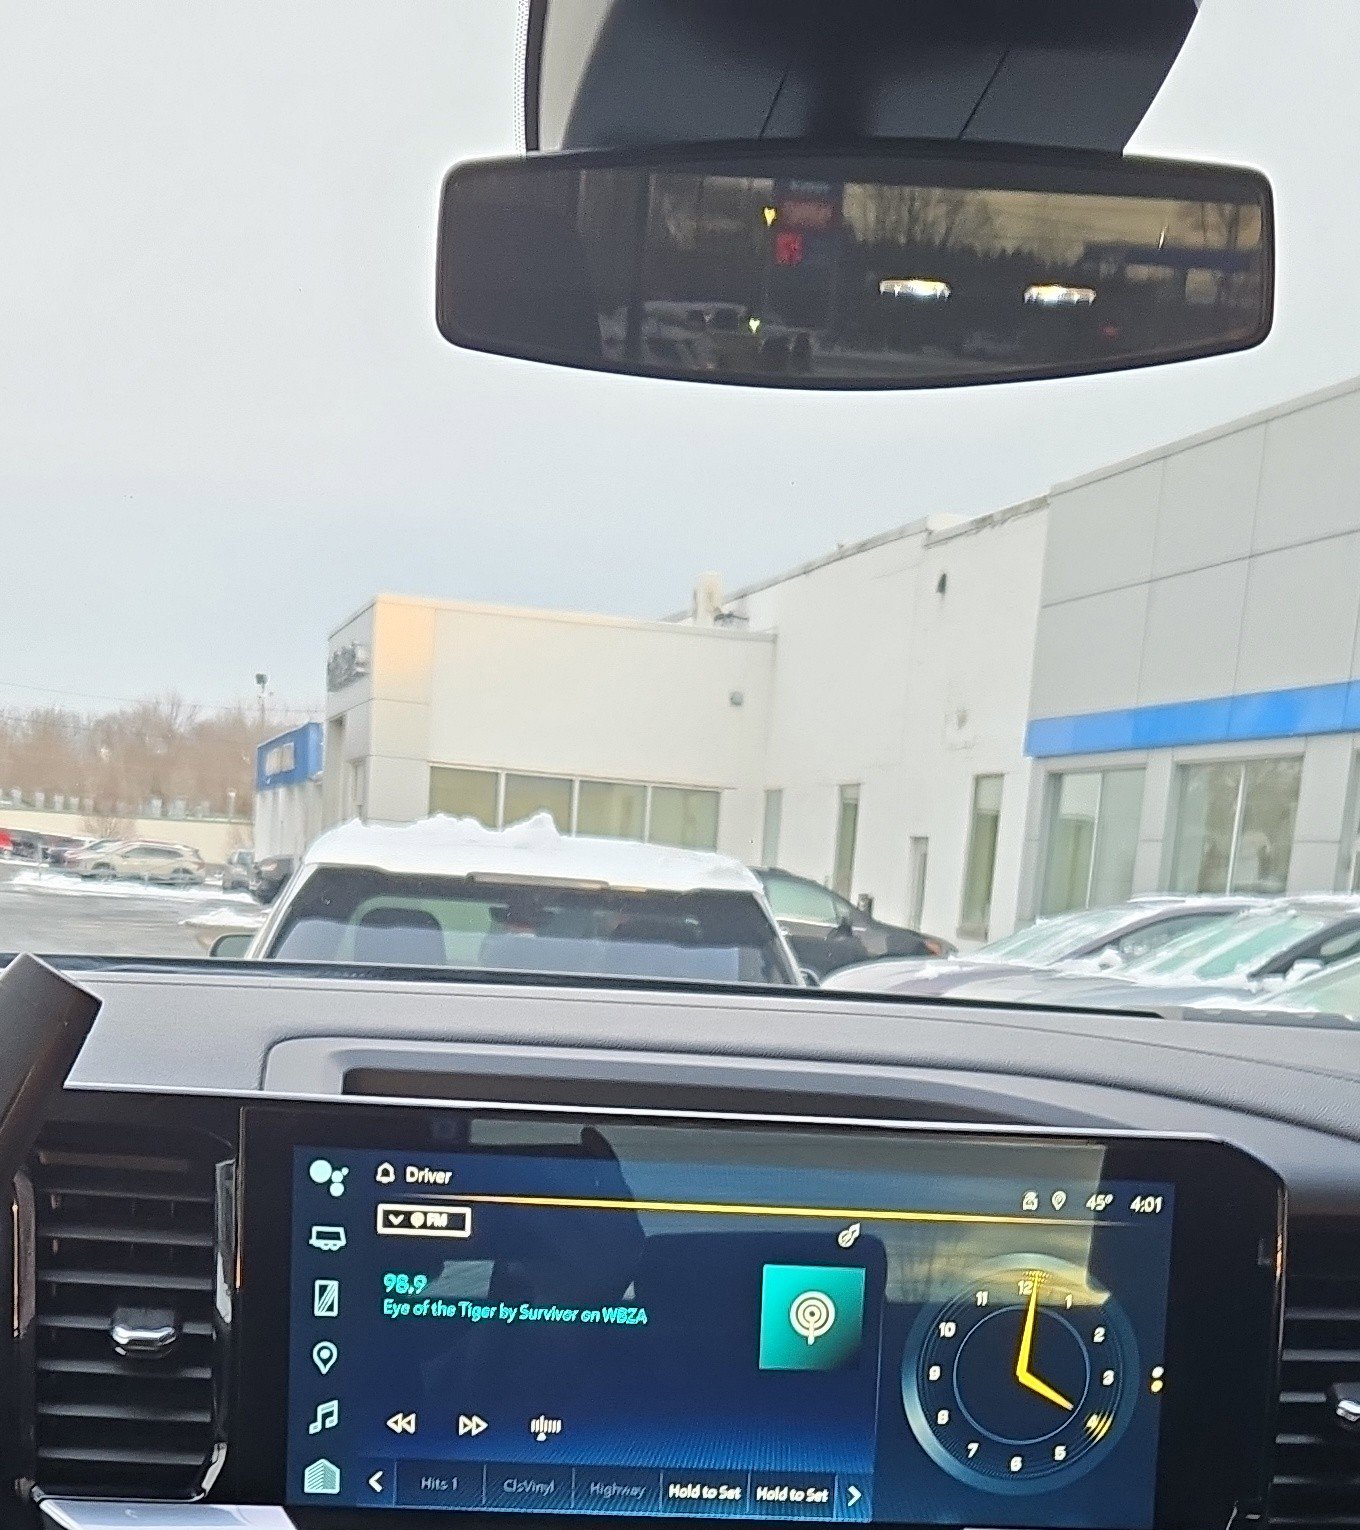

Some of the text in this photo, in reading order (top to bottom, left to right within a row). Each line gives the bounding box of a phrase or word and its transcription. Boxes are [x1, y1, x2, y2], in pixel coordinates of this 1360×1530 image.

[405, 1165, 452, 1184] Driver
[1130, 1195, 1164, 1213] 4:01
[426, 1212, 448, 1228] FM
[383, 1273, 427, 1295] 98.9
[1017, 1279, 1035, 1296] 12
[975, 1290, 989, 1307] 11
[1064, 1293, 1073, 1310] 1
[383, 1298, 648, 1325] Eye of the Tiger by Survivor on WBZA
[938, 1321, 957, 1338] 10
[1092, 1326, 1106, 1343] 2
[928, 1365, 941, 1381] 9
[1102, 1369, 1115, 1386] 3
[936, 1409, 950, 1425] 8
[967, 1442, 980, 1458] 7
[1054, 1445, 1067, 1461] 5
[1010, 1456, 1023, 1472] 6
[420, 1475, 449, 1491] Hits
[589, 1481, 647, 1500] Highway
[668, 1483, 742, 1501] Hold to Set
[756, 1485, 830, 1503] Hold to Set
